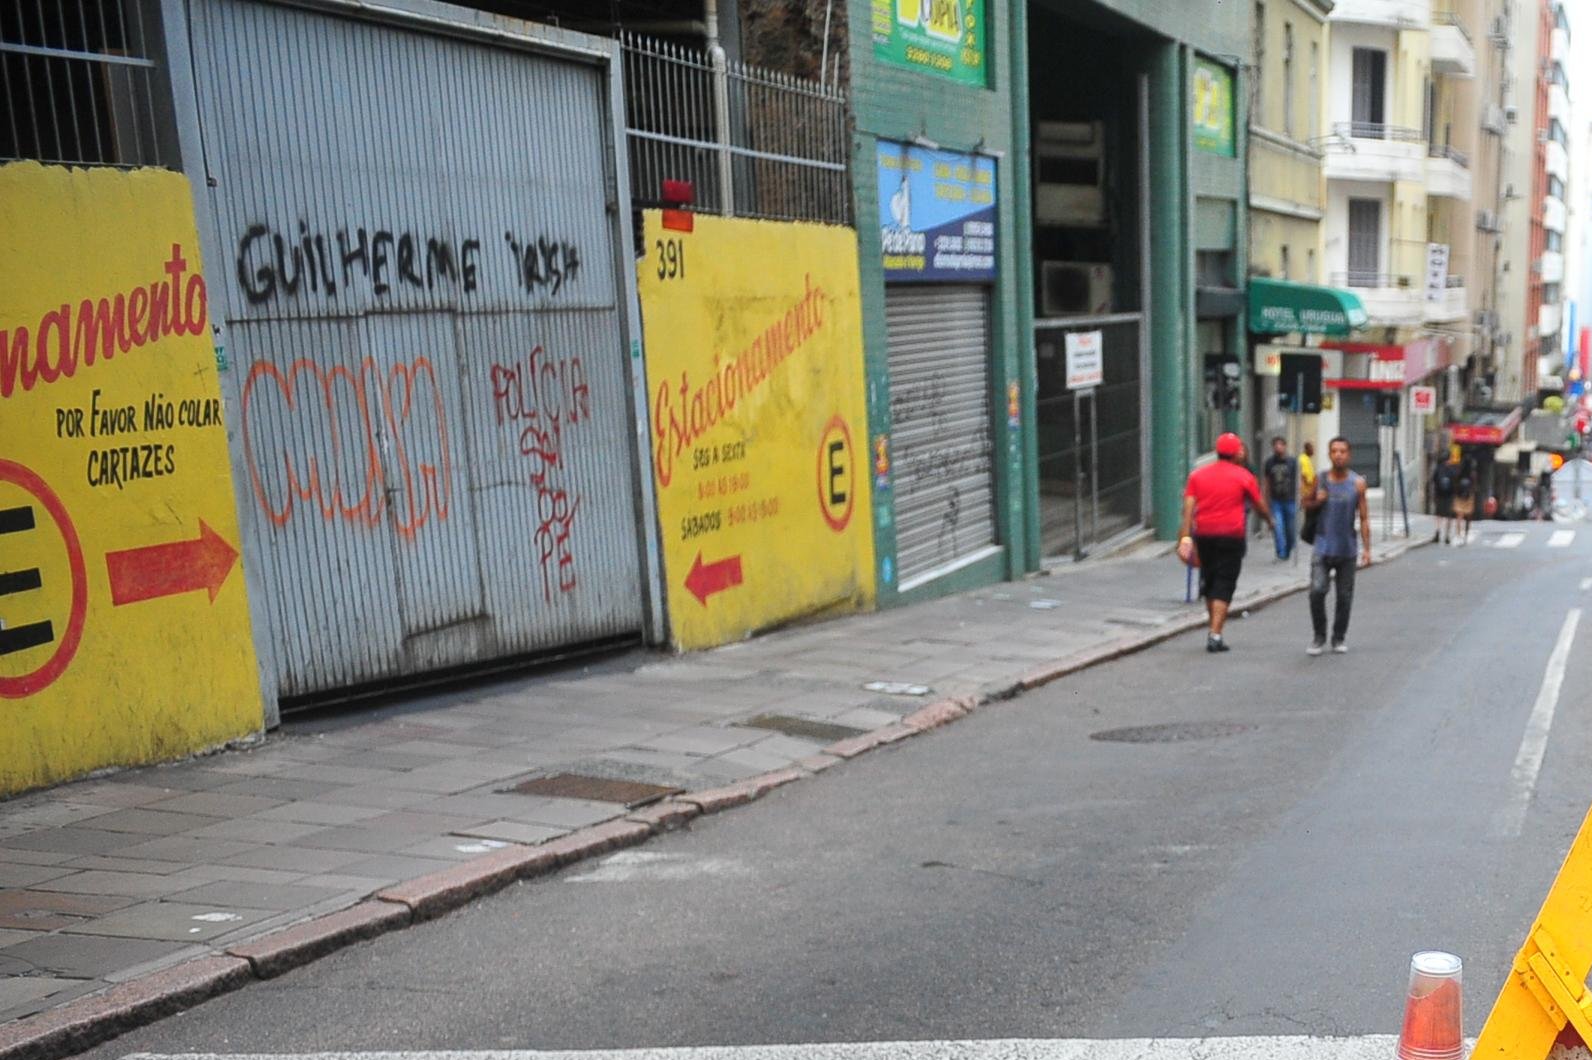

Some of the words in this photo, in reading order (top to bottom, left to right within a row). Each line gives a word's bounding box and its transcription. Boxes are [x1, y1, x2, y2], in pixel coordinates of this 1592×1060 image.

[656, 238, 684, 281] 391
[654, 273, 827, 489] Estacionamento
[56, 408, 84, 438] POR
[90, 389, 137, 437] FAVOR
[178, 399, 222, 427] COLAR
[87, 444, 175, 490] CARTAZES
[828, 442, 847, 505] E
